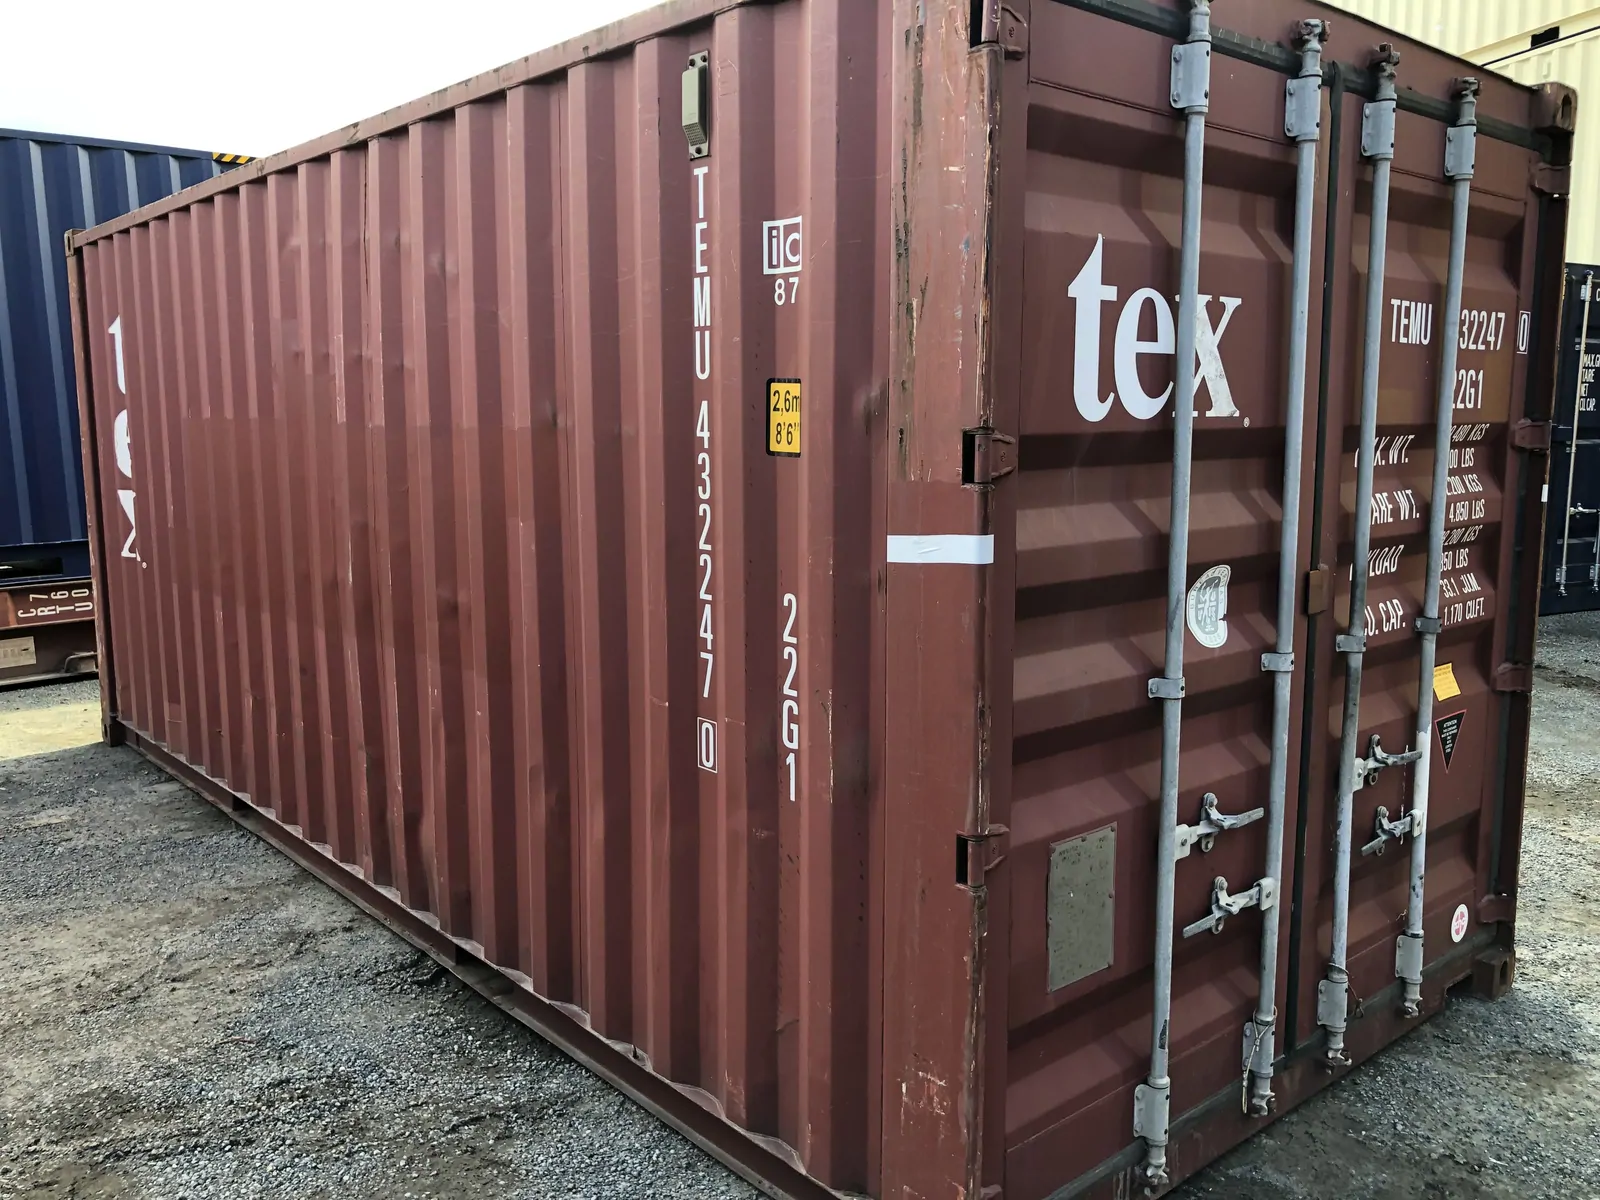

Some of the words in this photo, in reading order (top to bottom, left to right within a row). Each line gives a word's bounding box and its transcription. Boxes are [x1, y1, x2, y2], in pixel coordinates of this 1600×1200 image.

[693, 166, 711, 380] TEMU
[774, 277, 799, 306] 87
[1391, 298, 1433, 345] TEMU
[1459, 309, 1506, 351] 32247
[1389, 434, 1415, 465] WT.
[1461, 447, 1475, 468] LBS
[1462, 473, 1483, 492] KGS
[1370, 491, 1394, 525] ARE
[1393, 489, 1420, 520] WT.
[1449, 502, 1469, 523] 4.850
[1471, 498, 1486, 519] LBS
[696, 400, 714, 698] 432247
[1455, 547, 1469, 569] LBS
[1440, 576, 1460, 598] 33.1
[1378, 598, 1406, 632] CAP.
[782, 592, 800, 802] 22G1
